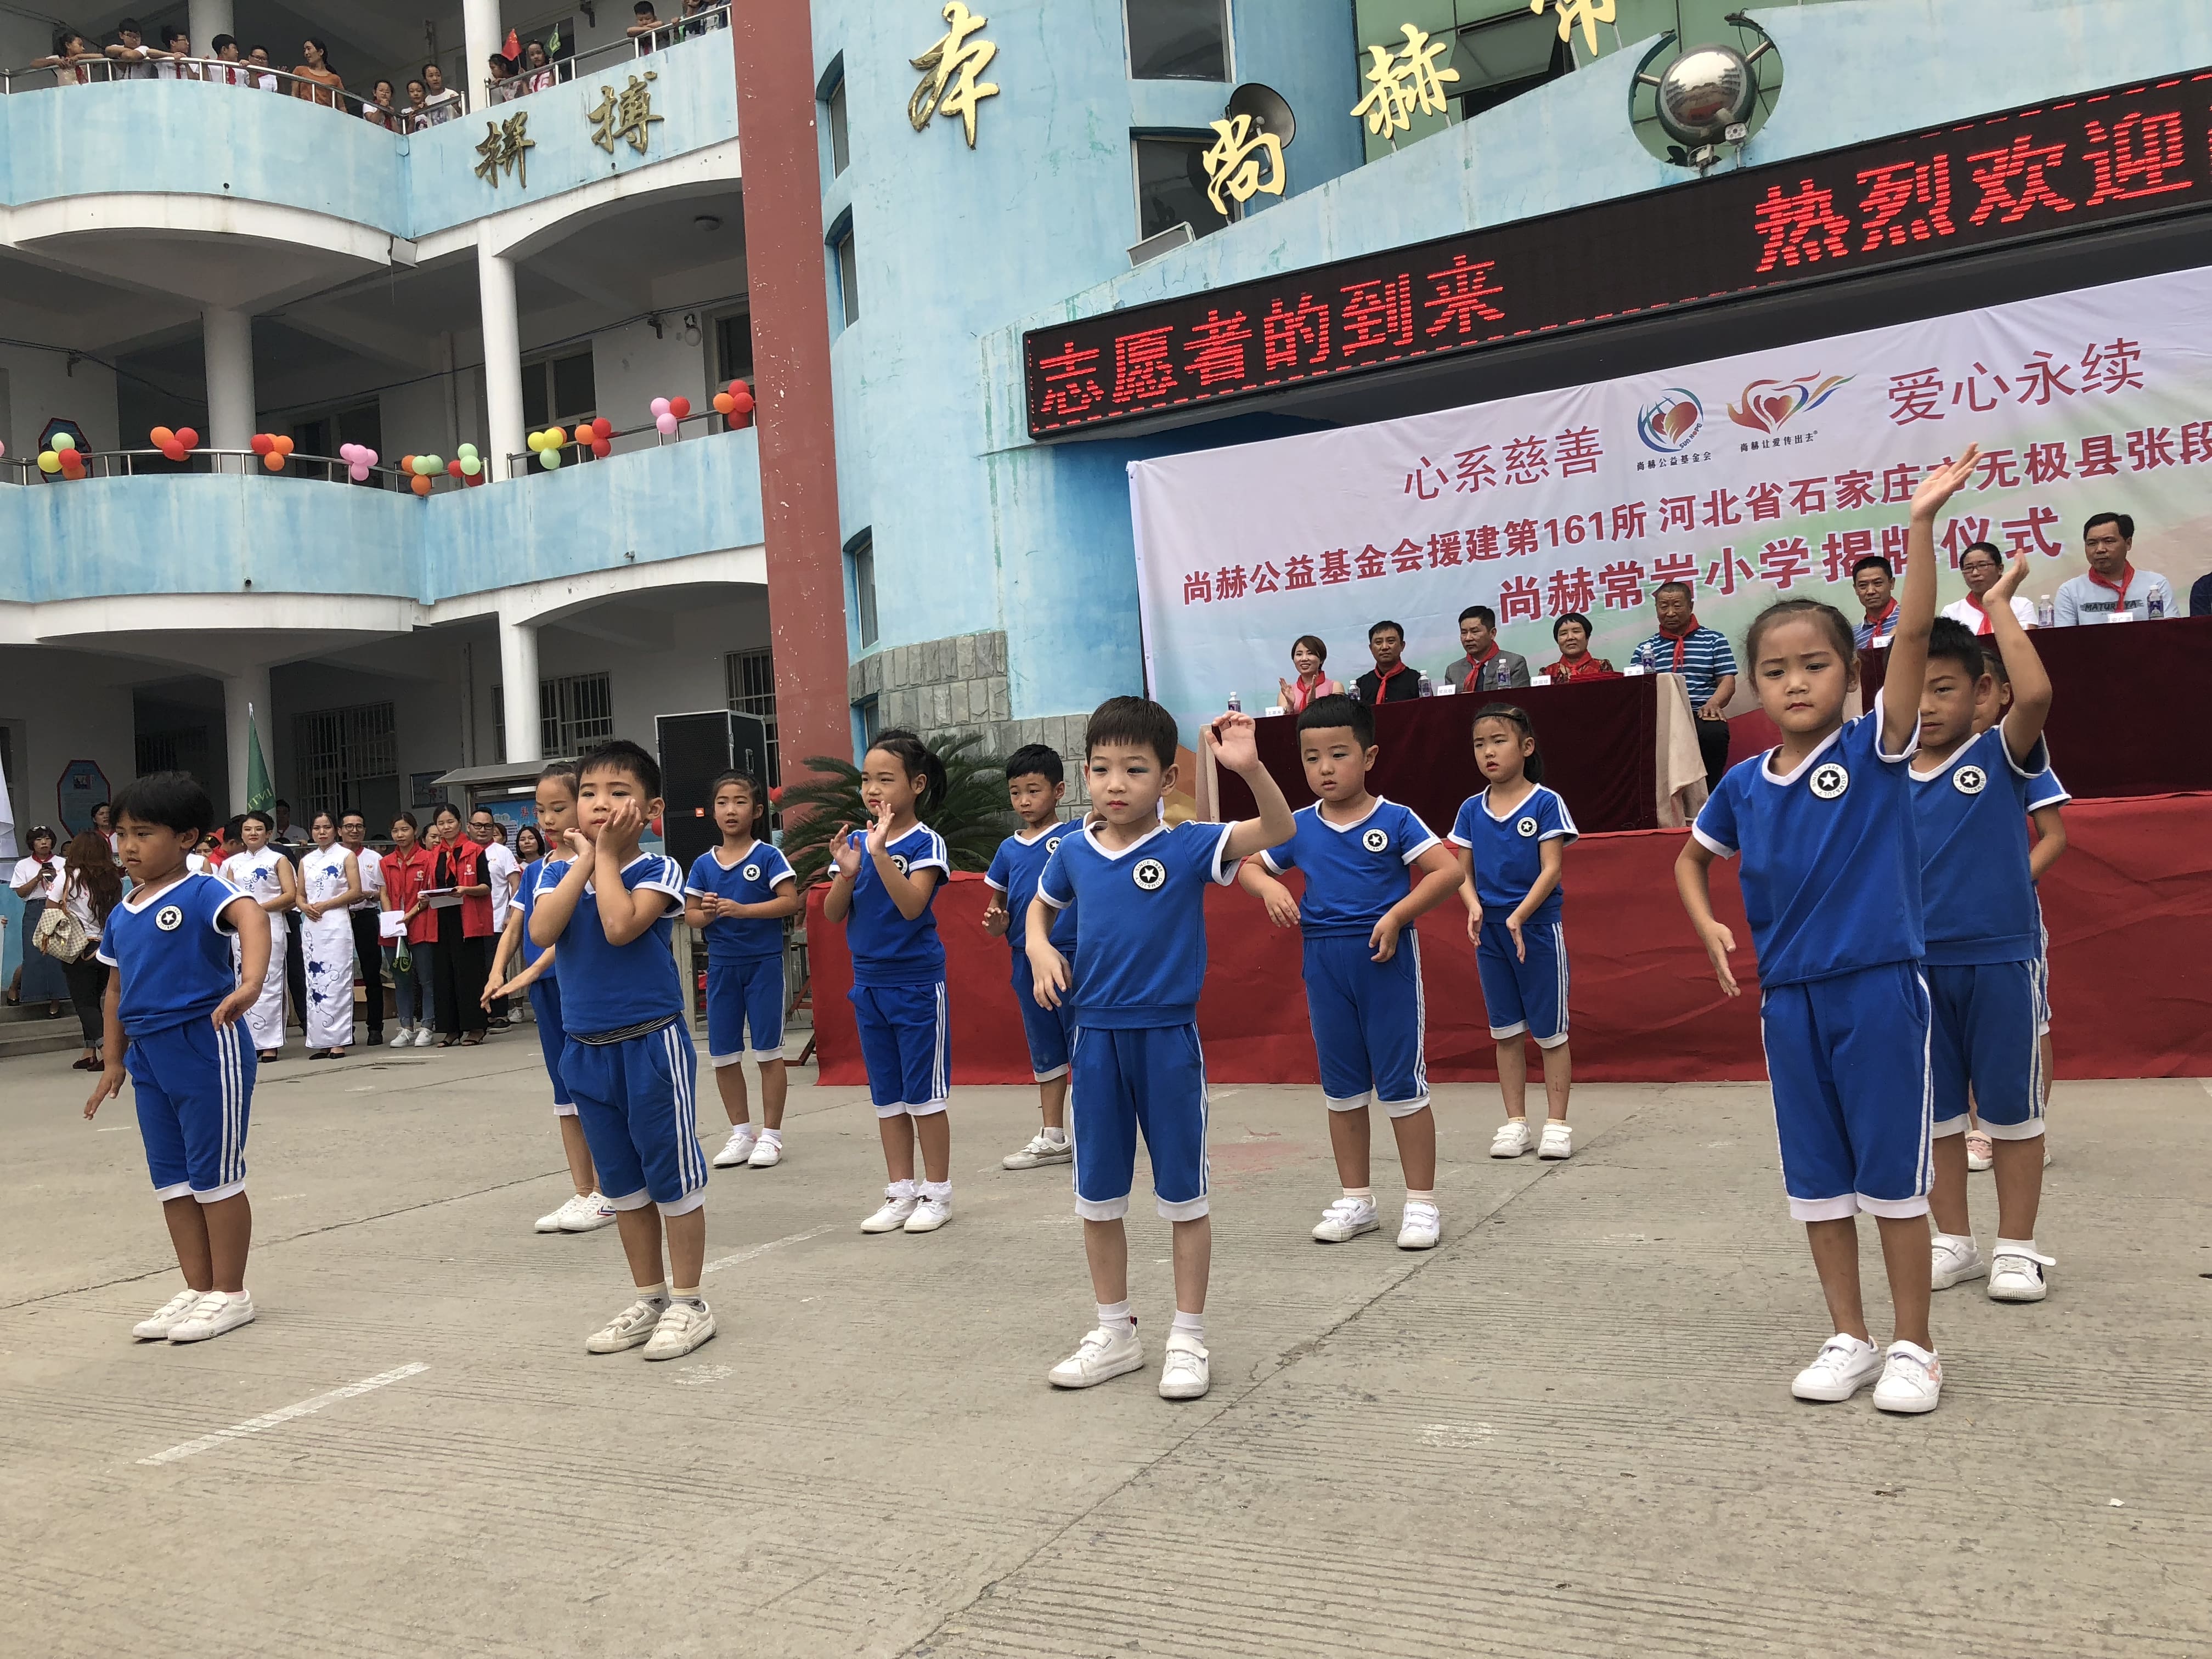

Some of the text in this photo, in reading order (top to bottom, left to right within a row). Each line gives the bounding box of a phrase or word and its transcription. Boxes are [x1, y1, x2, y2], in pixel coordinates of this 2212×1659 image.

[1040, 105, 2212, 416] 志愿者的到来 热烈欢迎
[1403, 337, 2145, 501] 心系慈善 爱心永续
[1637, 452, 1712, 471] 尚赫公益基金会
[1812, 769, 1822, 787] SINCE
[1136, 861, 1150, 871] SINCE
